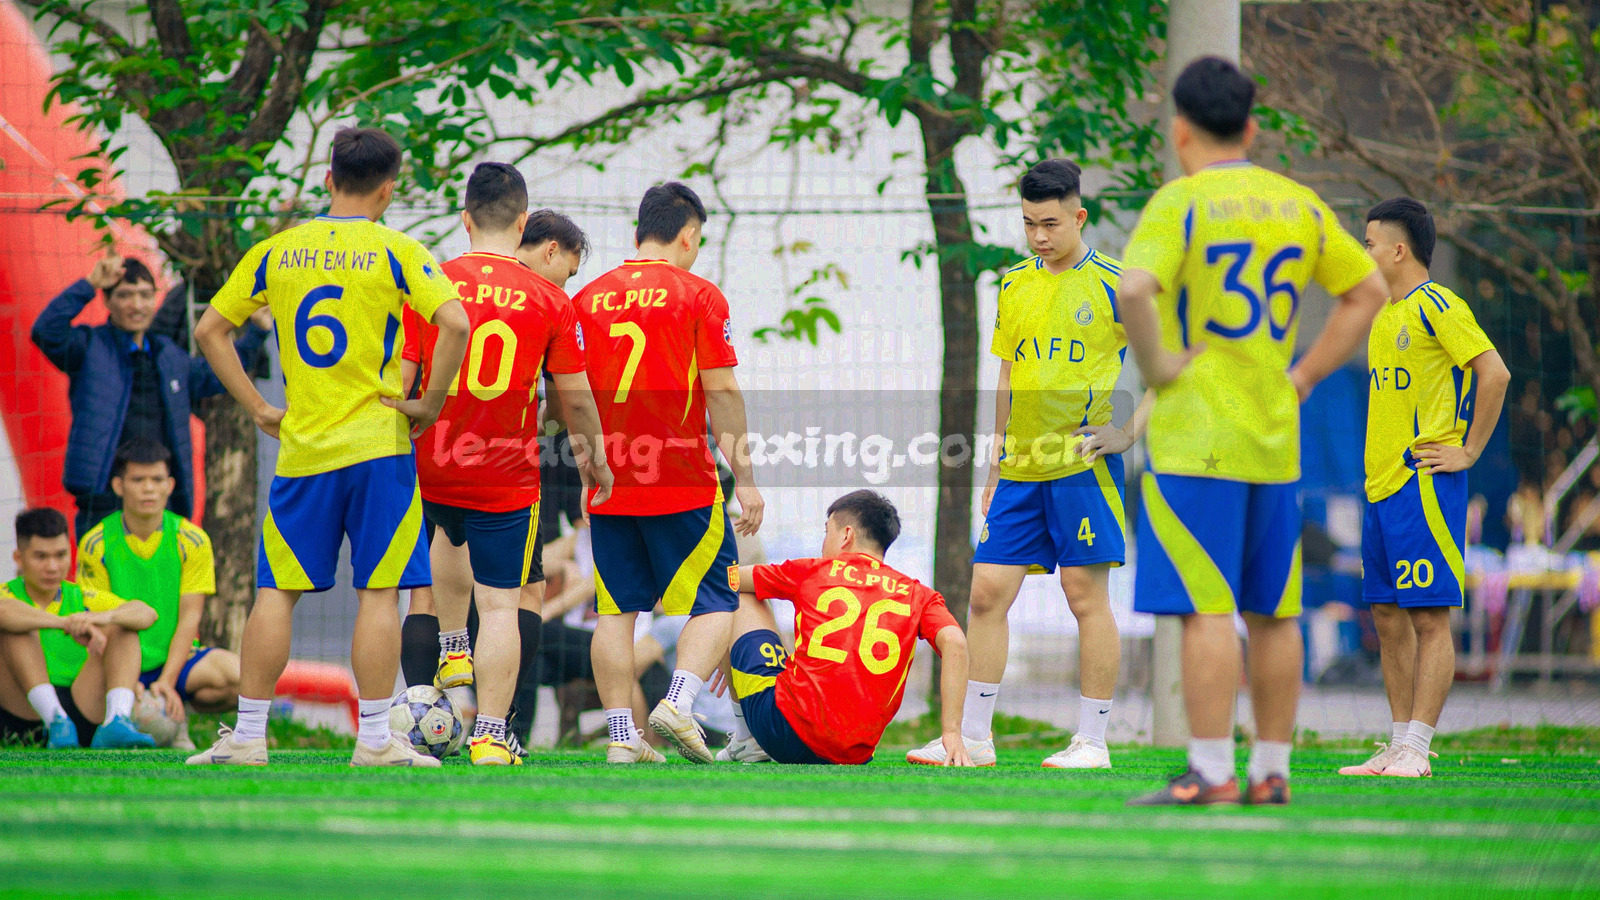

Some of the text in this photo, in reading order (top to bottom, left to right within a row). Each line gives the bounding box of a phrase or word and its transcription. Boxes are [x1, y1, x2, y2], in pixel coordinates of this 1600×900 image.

[278, 248, 377, 271] ANH EM WF
[591, 288, 668, 314] FC.PU2
[1205, 242, 1304, 342] 36
[294, 284, 348, 369] 6
[609, 321, 647, 403] 7
[1077, 517, 1096, 546] 4
[1395, 558, 1434, 590] 20
[806, 586, 911, 675] 26
